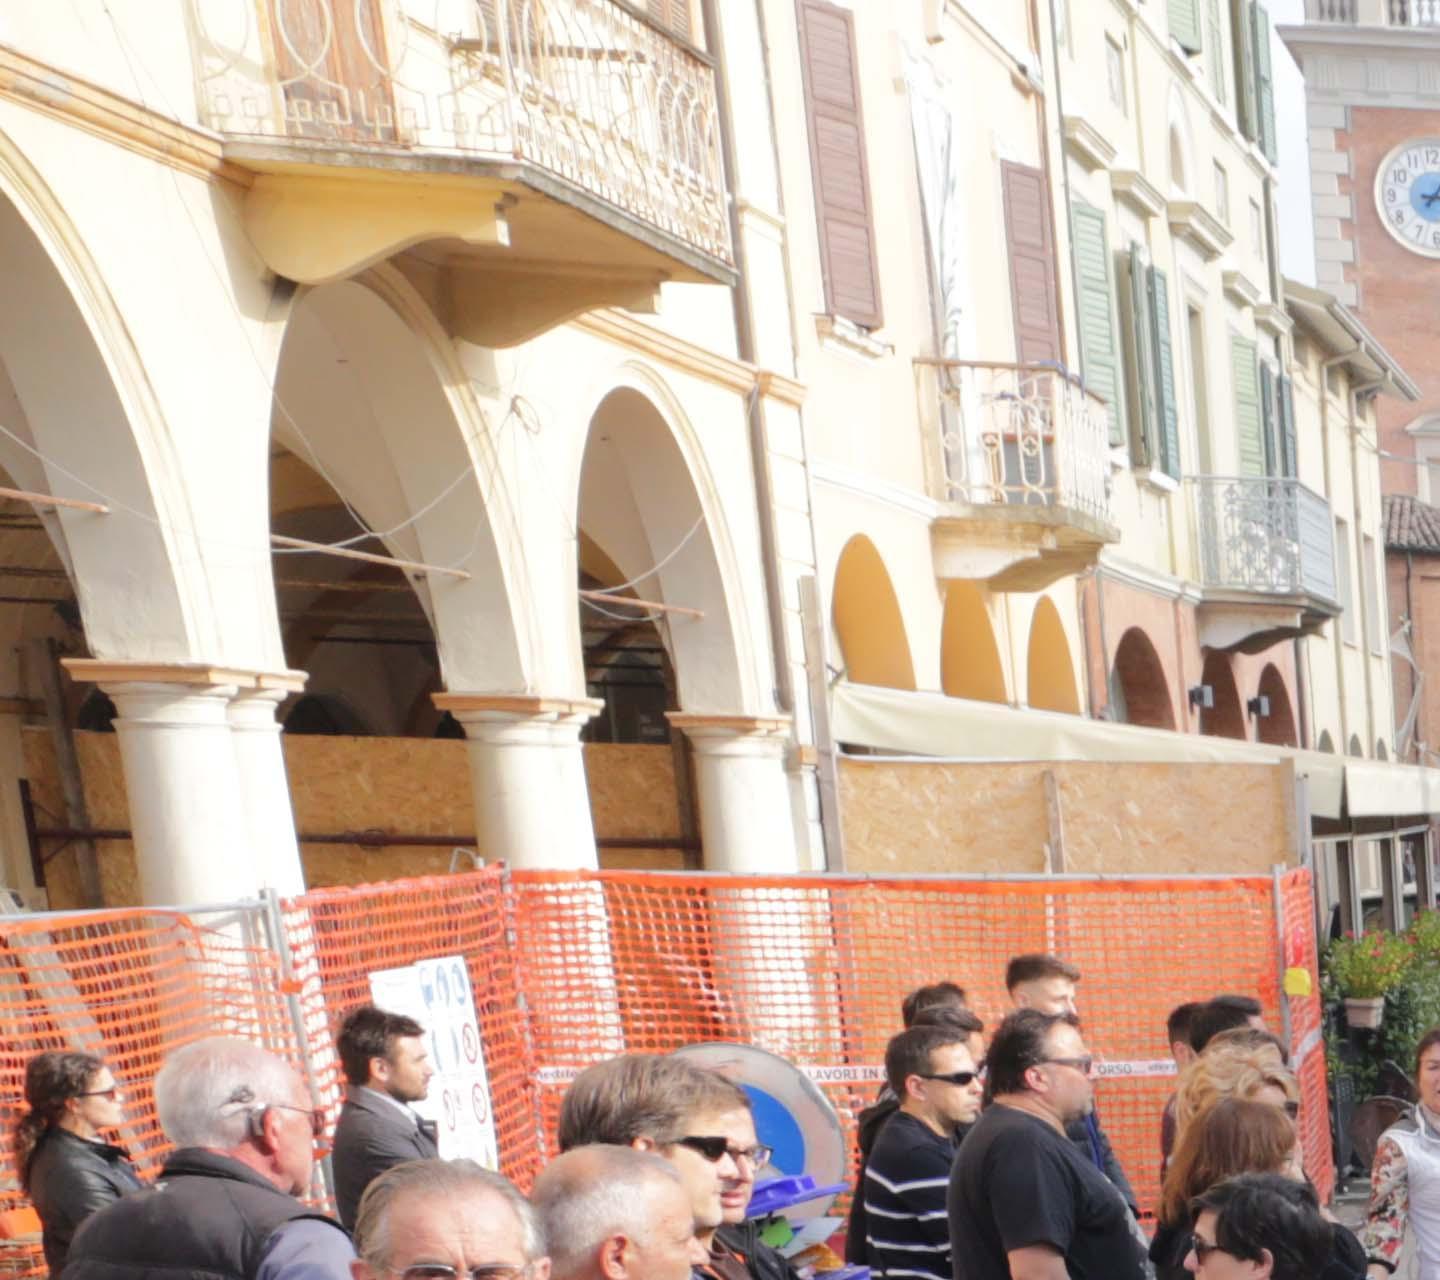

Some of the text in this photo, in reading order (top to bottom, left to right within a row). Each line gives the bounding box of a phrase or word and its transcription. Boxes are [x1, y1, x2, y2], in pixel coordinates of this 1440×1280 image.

[1425, 149, 1440, 165] 12
[1387, 188, 1397, 203] 9
[863, 1067, 879, 1080] IN
